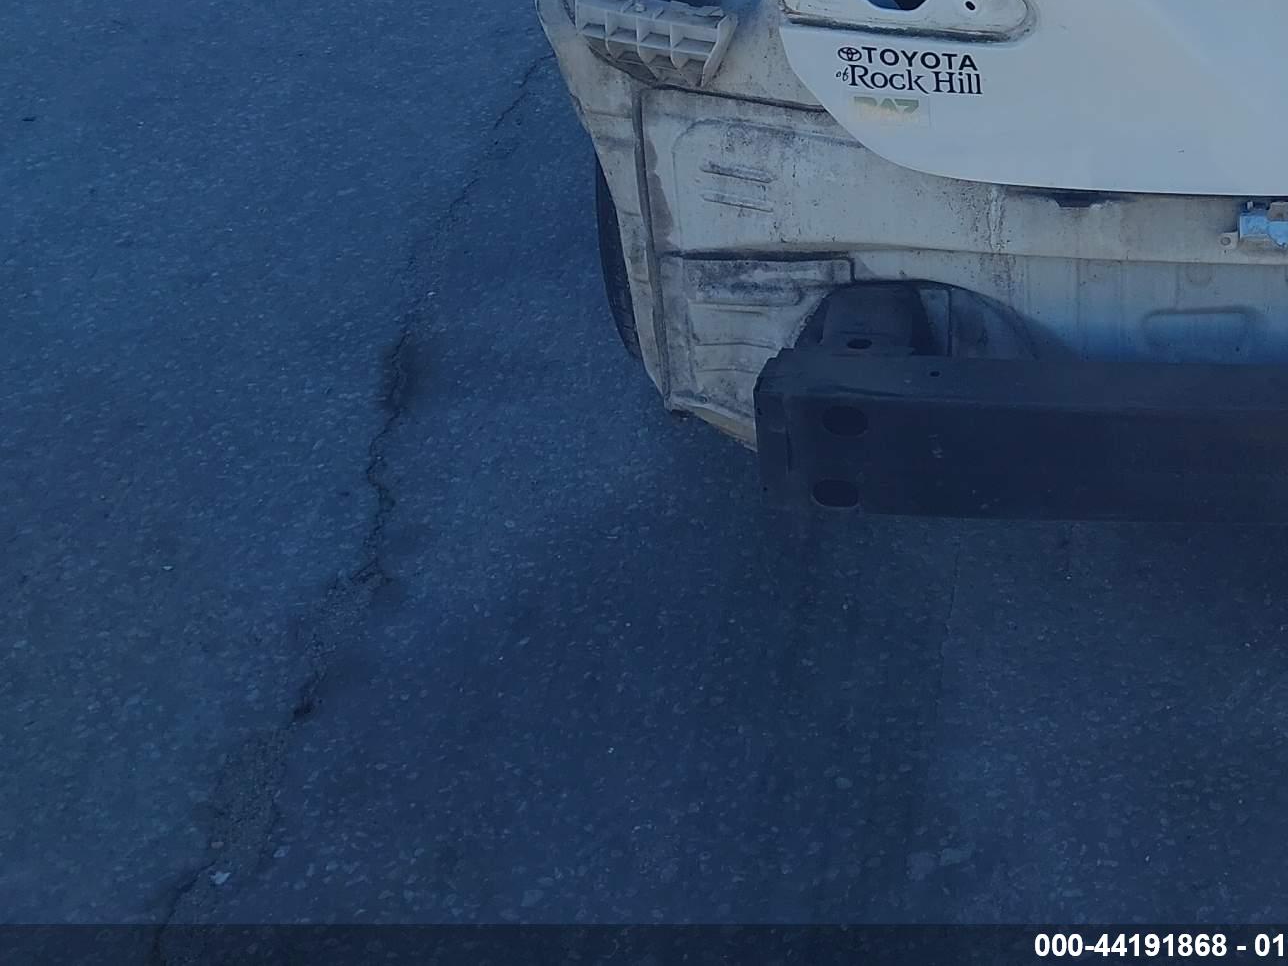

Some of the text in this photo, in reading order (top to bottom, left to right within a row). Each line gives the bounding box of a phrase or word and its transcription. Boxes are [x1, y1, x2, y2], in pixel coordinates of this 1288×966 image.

[861, 46, 978, 71] TOYOTA
[835, 64, 983, 95] of Rock Hill
